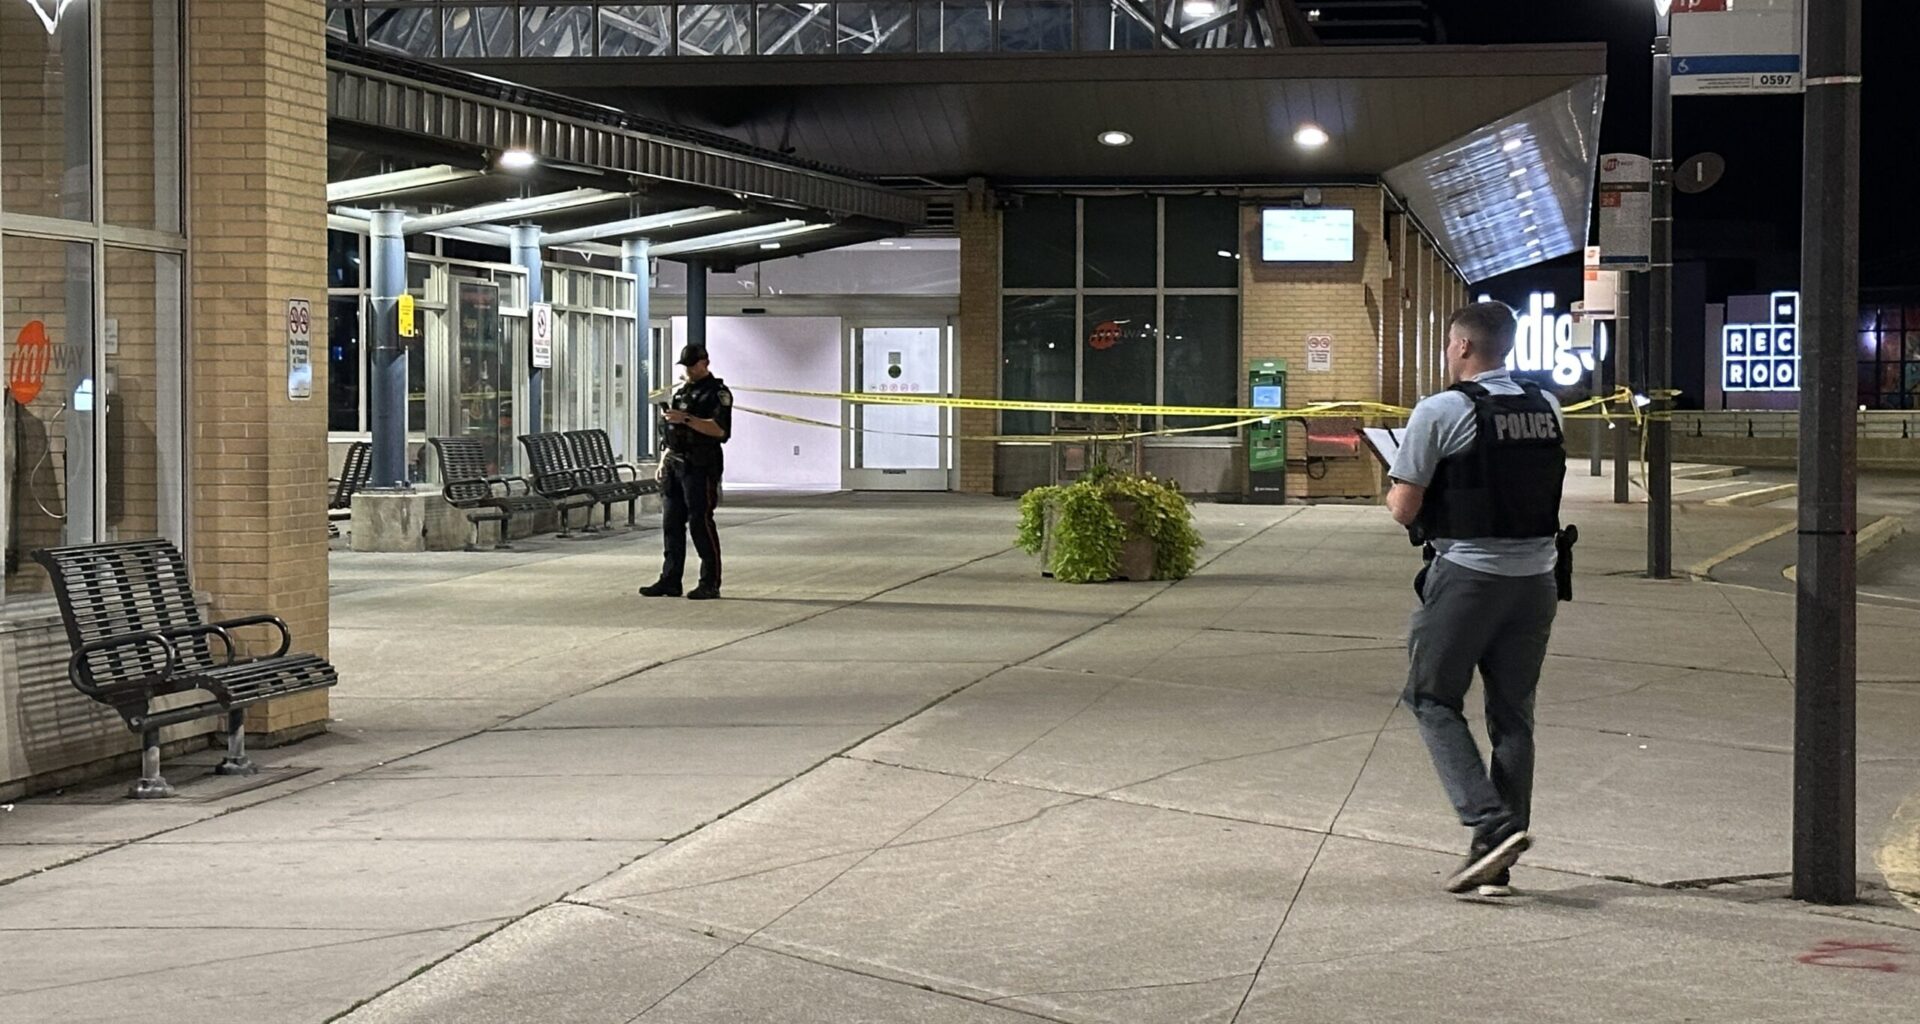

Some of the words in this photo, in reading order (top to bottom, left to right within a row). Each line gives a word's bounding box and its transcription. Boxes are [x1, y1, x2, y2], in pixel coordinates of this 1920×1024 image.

[1760, 74, 1793, 85] 0597
[1730, 331, 1792, 352] REC
[1730, 362, 1793, 384] ROO
[1494, 411, 1558, 440] POLICE
